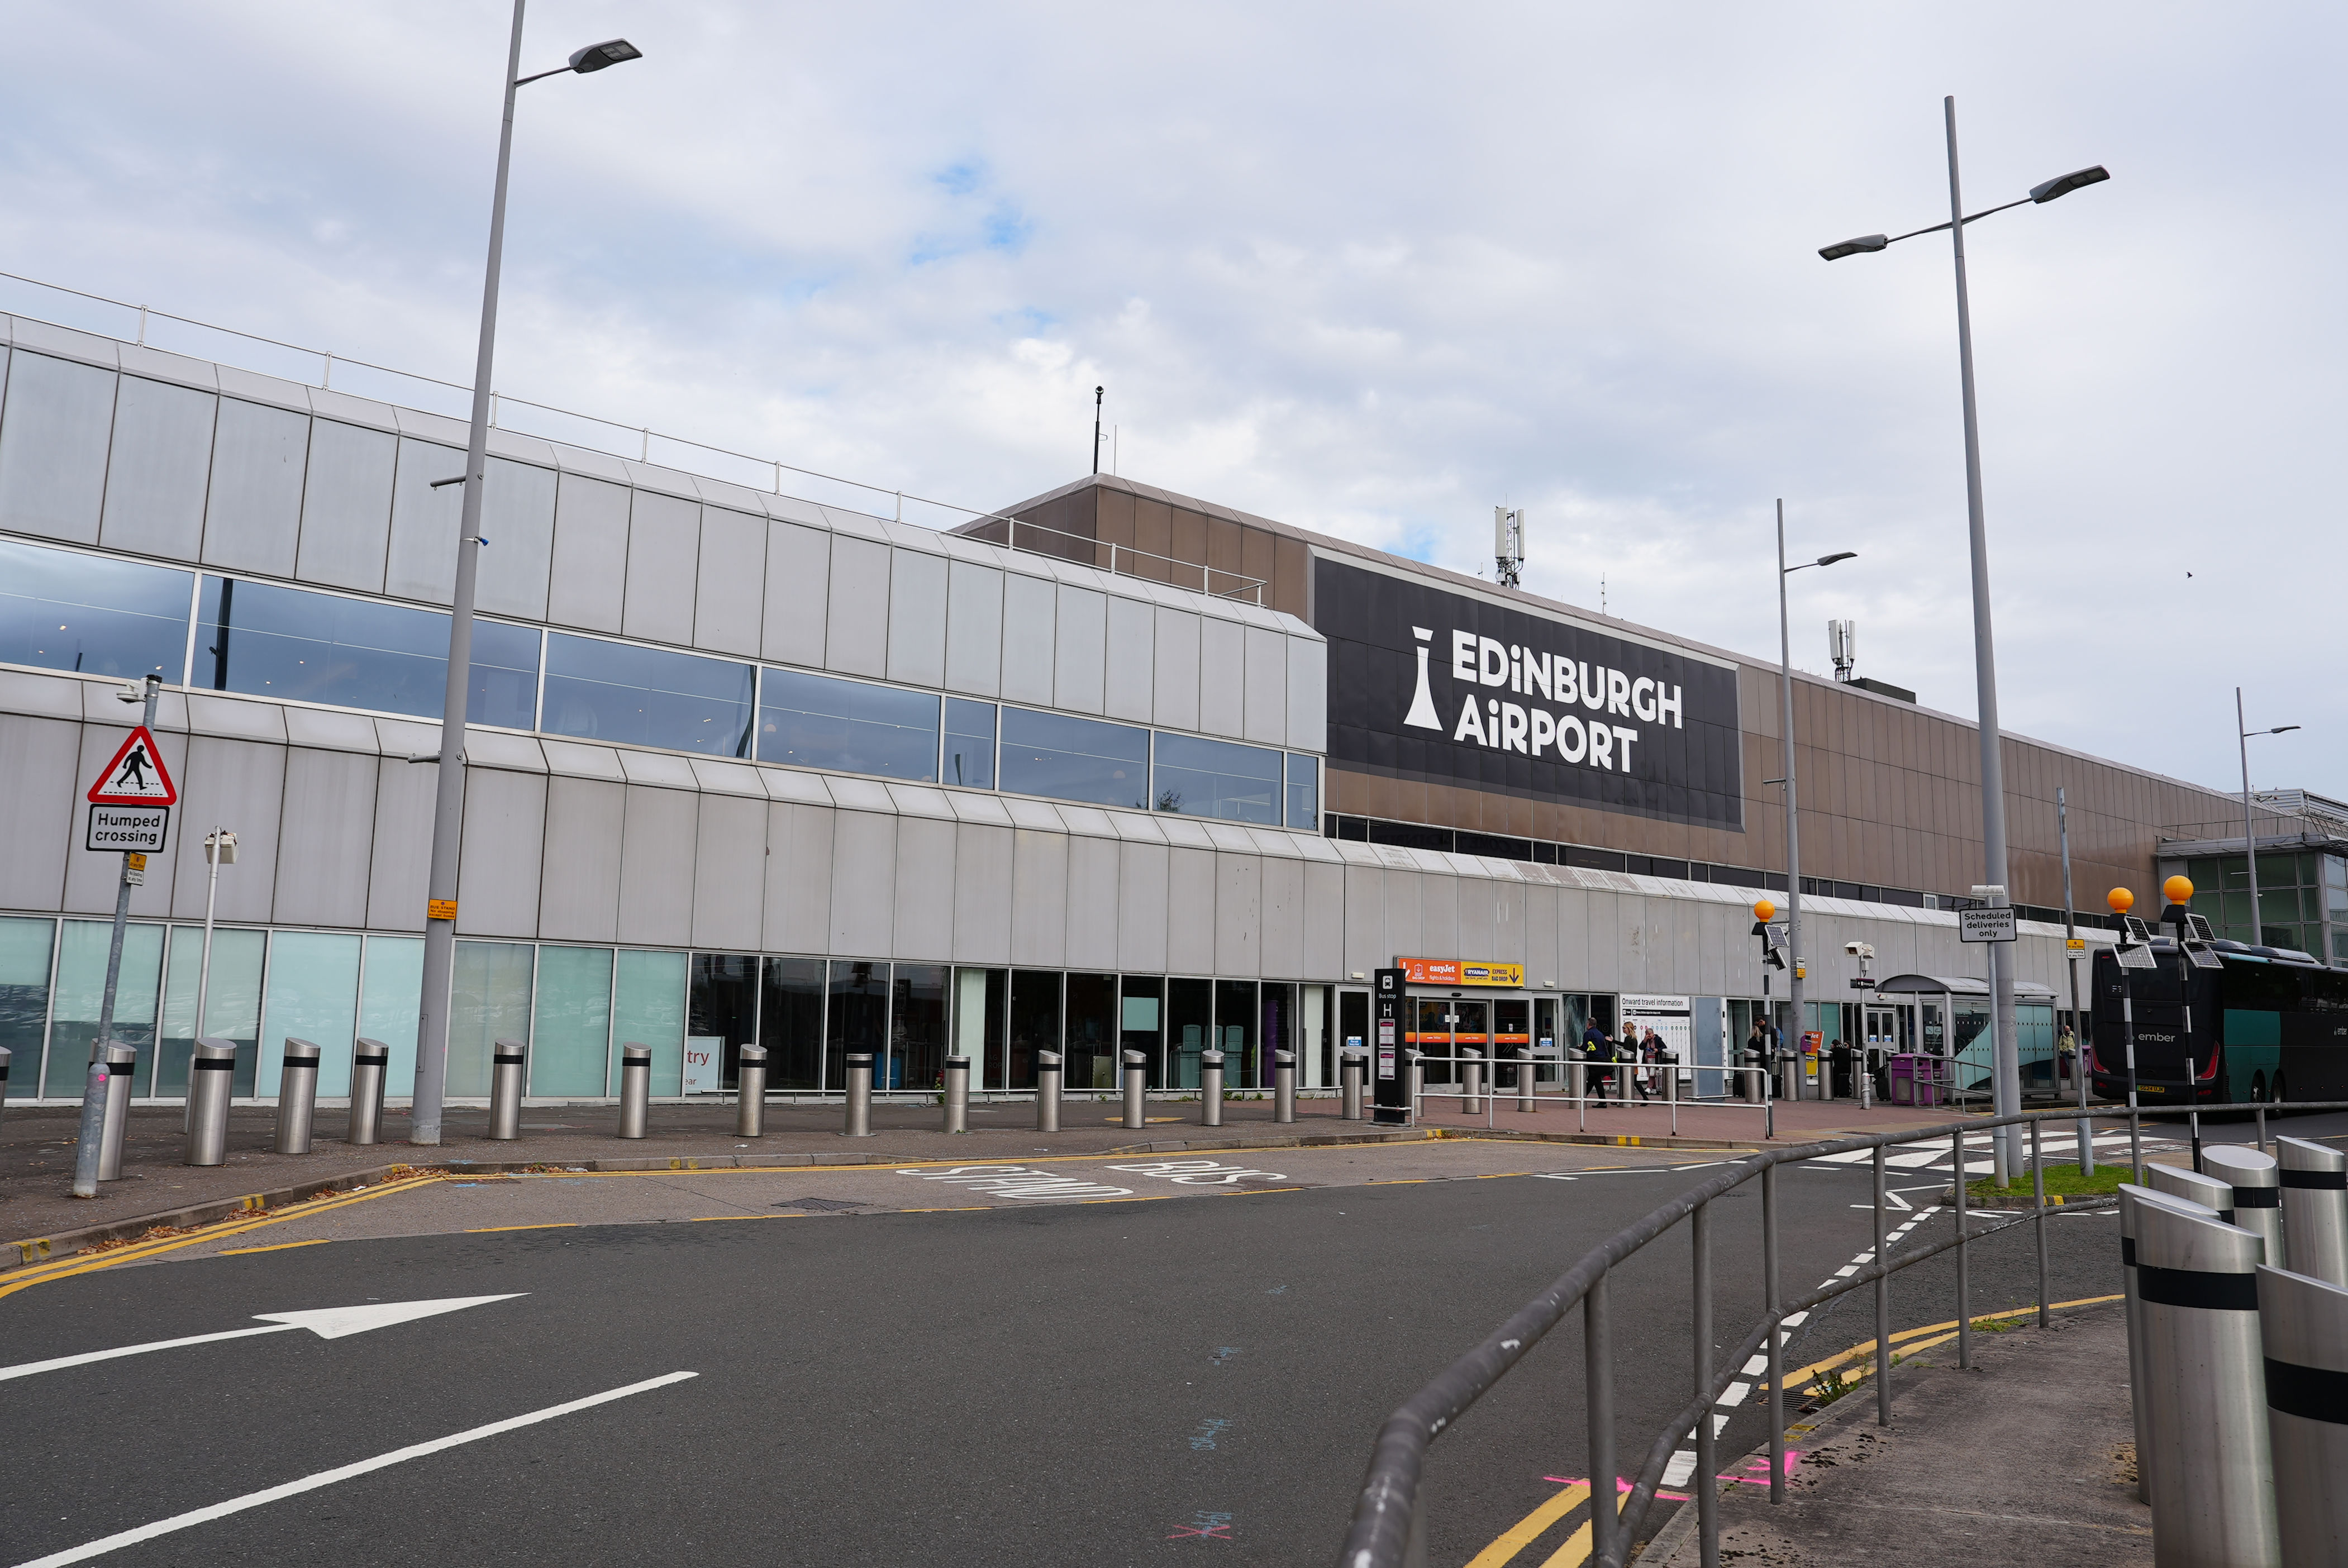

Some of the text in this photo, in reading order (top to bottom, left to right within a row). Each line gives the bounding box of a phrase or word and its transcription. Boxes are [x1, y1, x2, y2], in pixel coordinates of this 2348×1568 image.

[98, 813, 160, 829] Humped
[96, 830, 158, 845] crossing
[1964, 912, 2011, 920] Scheduled
[1979, 930, 1997, 938] only
[1429, 964, 1455, 974] easyJet
[1383, 1003, 1392, 1017] H
[2138, 1032, 2176, 1042] ember
[687, 1050, 709, 1066] try
